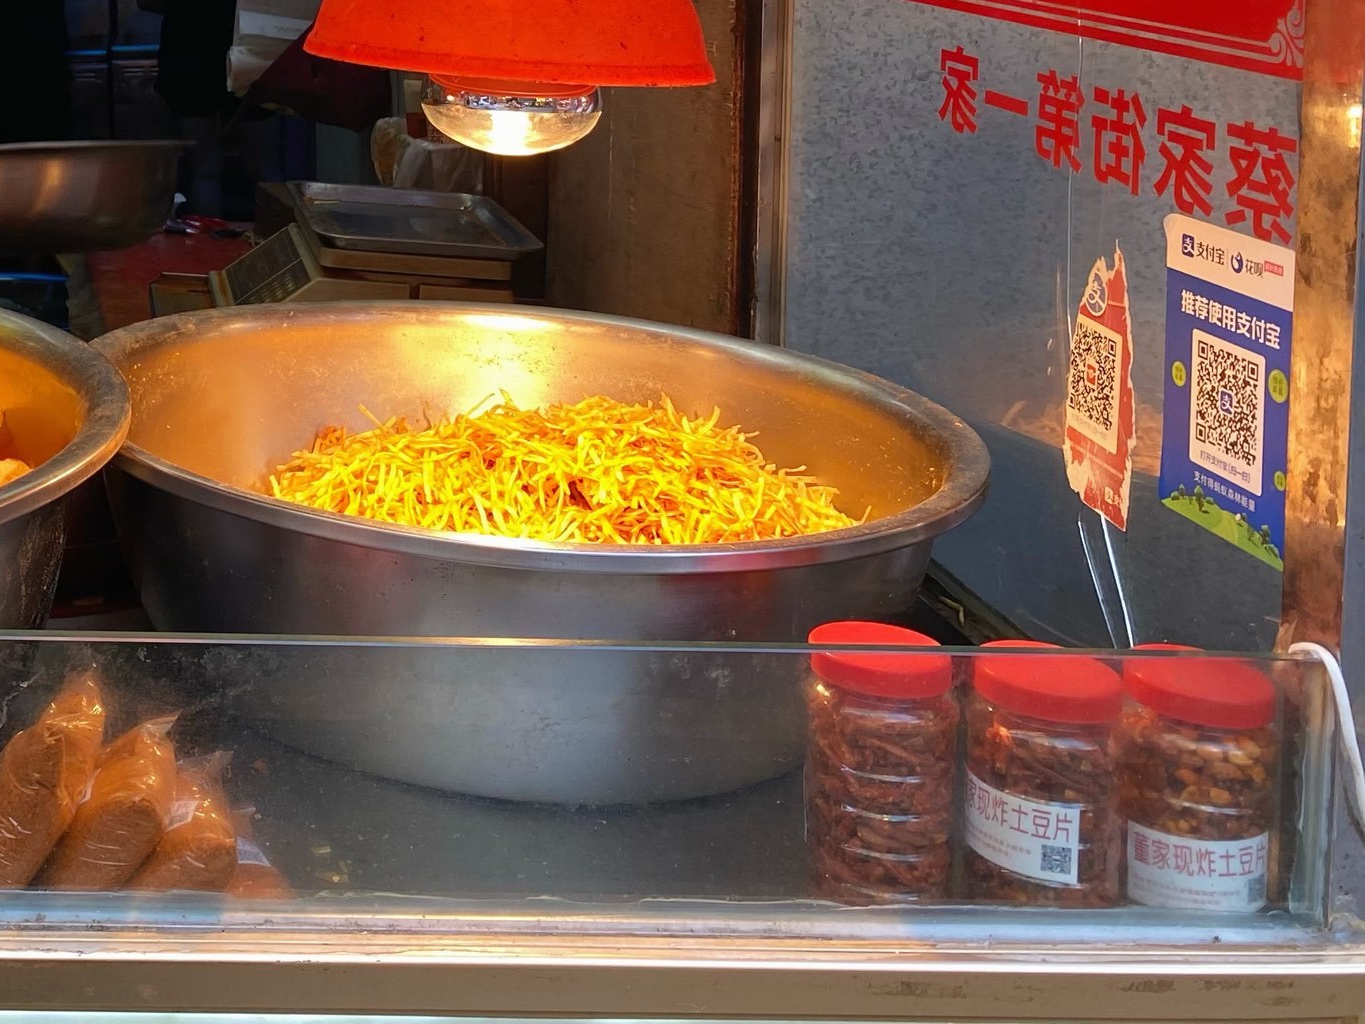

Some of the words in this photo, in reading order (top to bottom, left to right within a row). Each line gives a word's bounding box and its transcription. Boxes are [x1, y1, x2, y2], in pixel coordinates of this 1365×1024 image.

[1196, 241, 1225, 266] 支付宝
[1181, 289, 1281, 350] 推荐使用支付宝
[1133, 831, 1267, 878] 董家现炸土豆片
